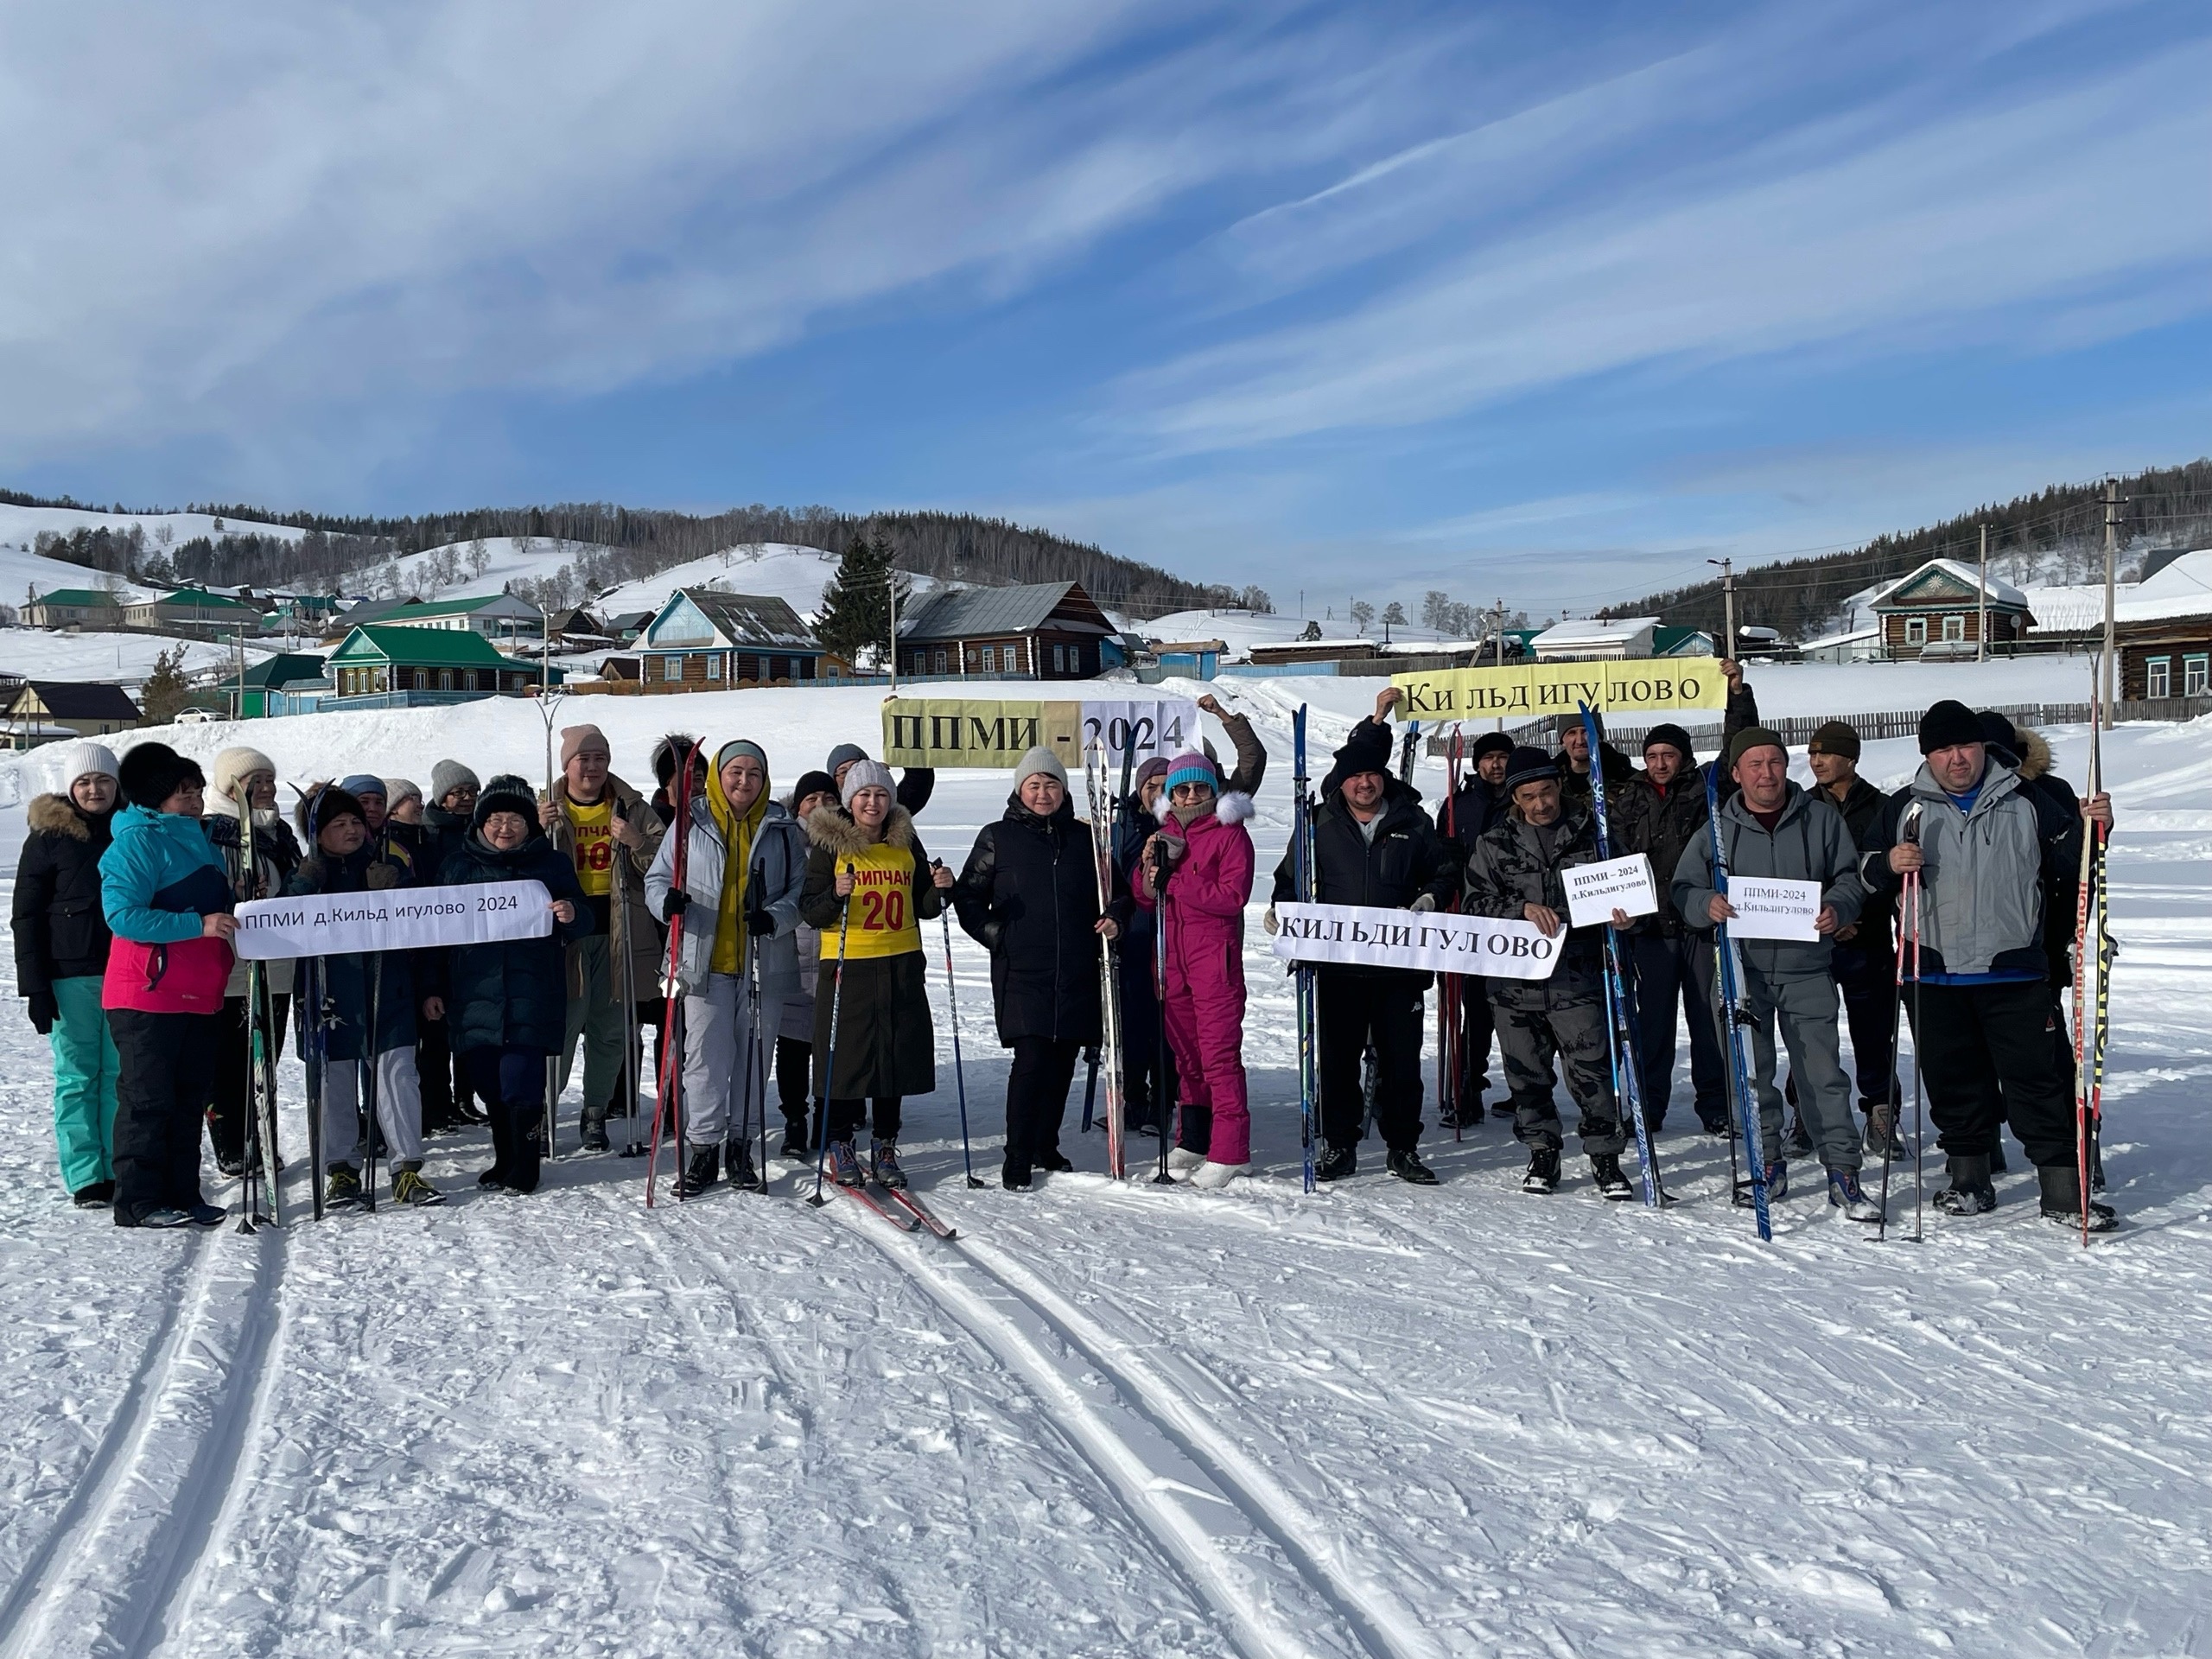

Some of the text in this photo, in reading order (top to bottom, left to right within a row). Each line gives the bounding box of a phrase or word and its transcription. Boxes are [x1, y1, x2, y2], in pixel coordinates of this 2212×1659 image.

[889, 715, 1040, 751] ППМИ
[1083, 715, 1185, 752] 2024
[1571, 879, 1647, 901] д.Кильдигулово
[1573, 871, 1609, 887] ППМИ
[1618, 865, 1639, 877] 2024
[1744, 887, 1807, 901] ППМИ-2024
[245, 912, 305, 931] ППМИ
[476, 895, 518, 912] 2024
[862, 890, 904, 931] 20
